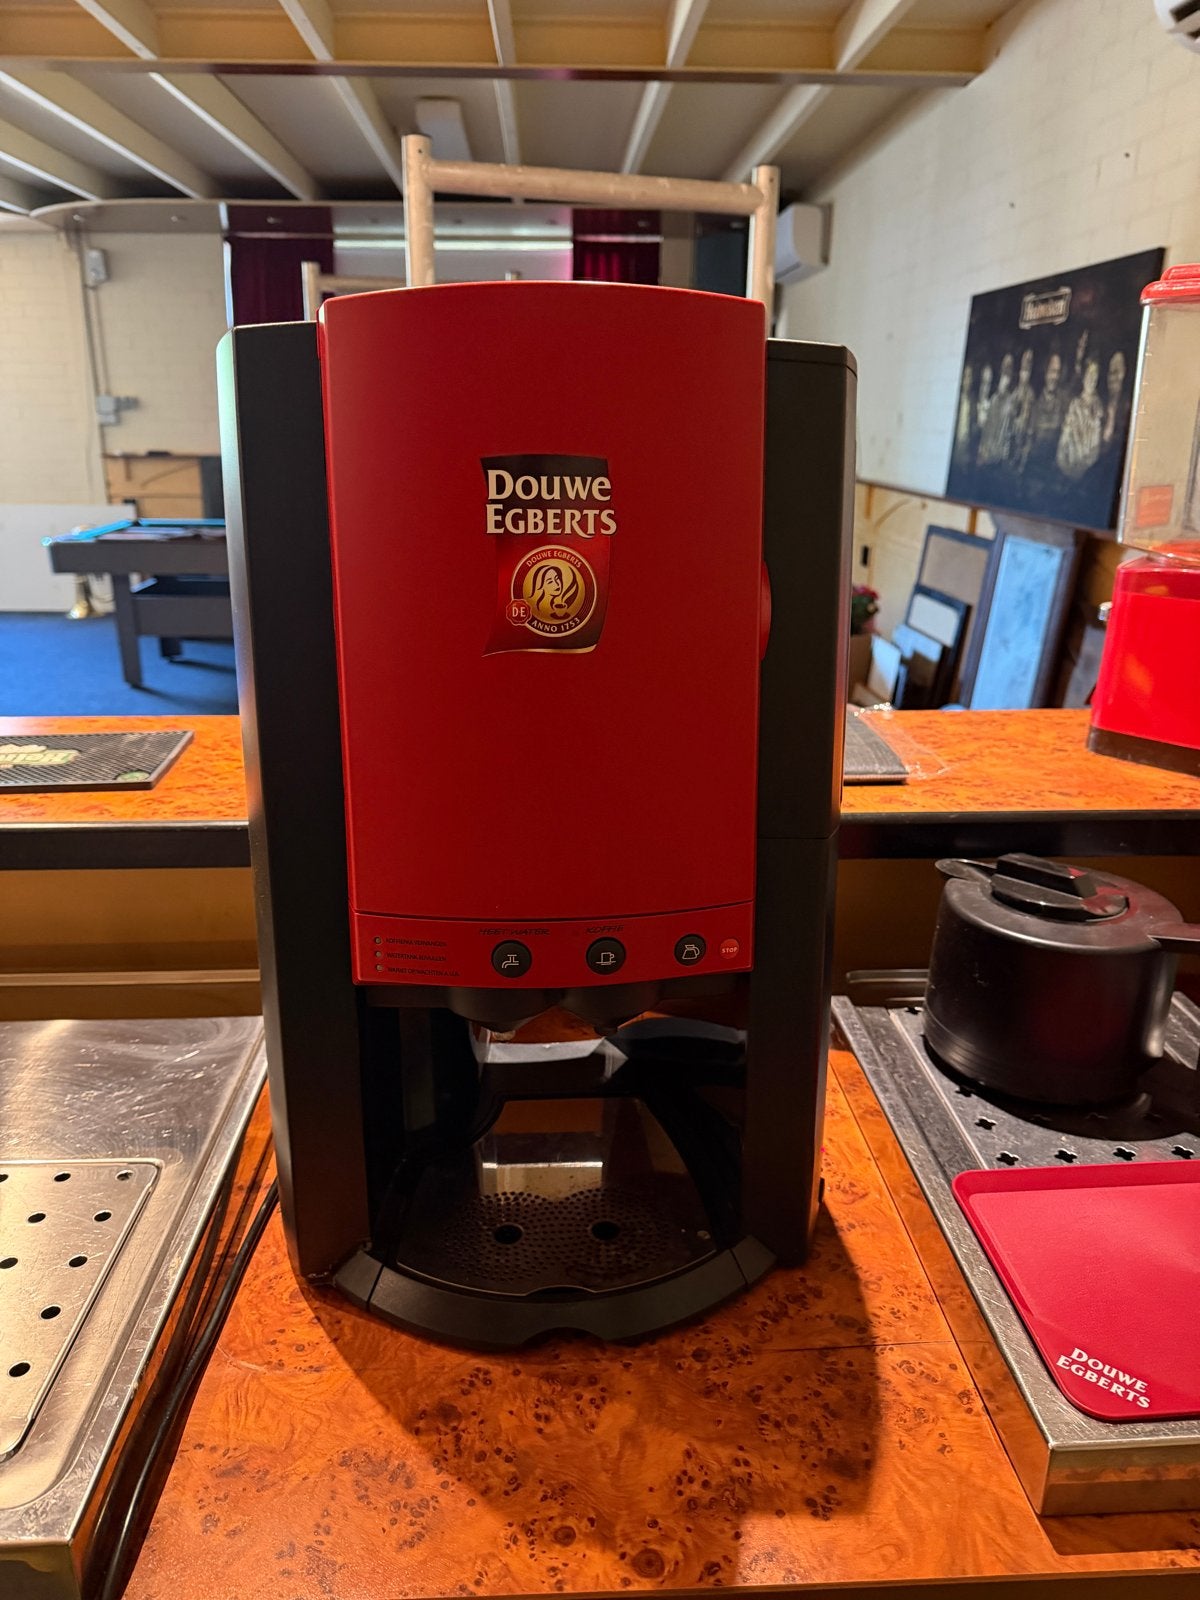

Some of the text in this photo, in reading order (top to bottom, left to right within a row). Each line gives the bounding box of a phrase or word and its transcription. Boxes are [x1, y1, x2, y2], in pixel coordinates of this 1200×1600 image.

[486, 503, 617, 538] EGBERTS
[526, 550, 583, 568] DOUWE EGBERTS
[531, 617, 581, 633] ANNO 1753
[721, 946, 738, 954] STOP
[1056, 1354, 1151, 1408] EGBERTS
[1070, 1347, 1148, 1393] DOUWE
